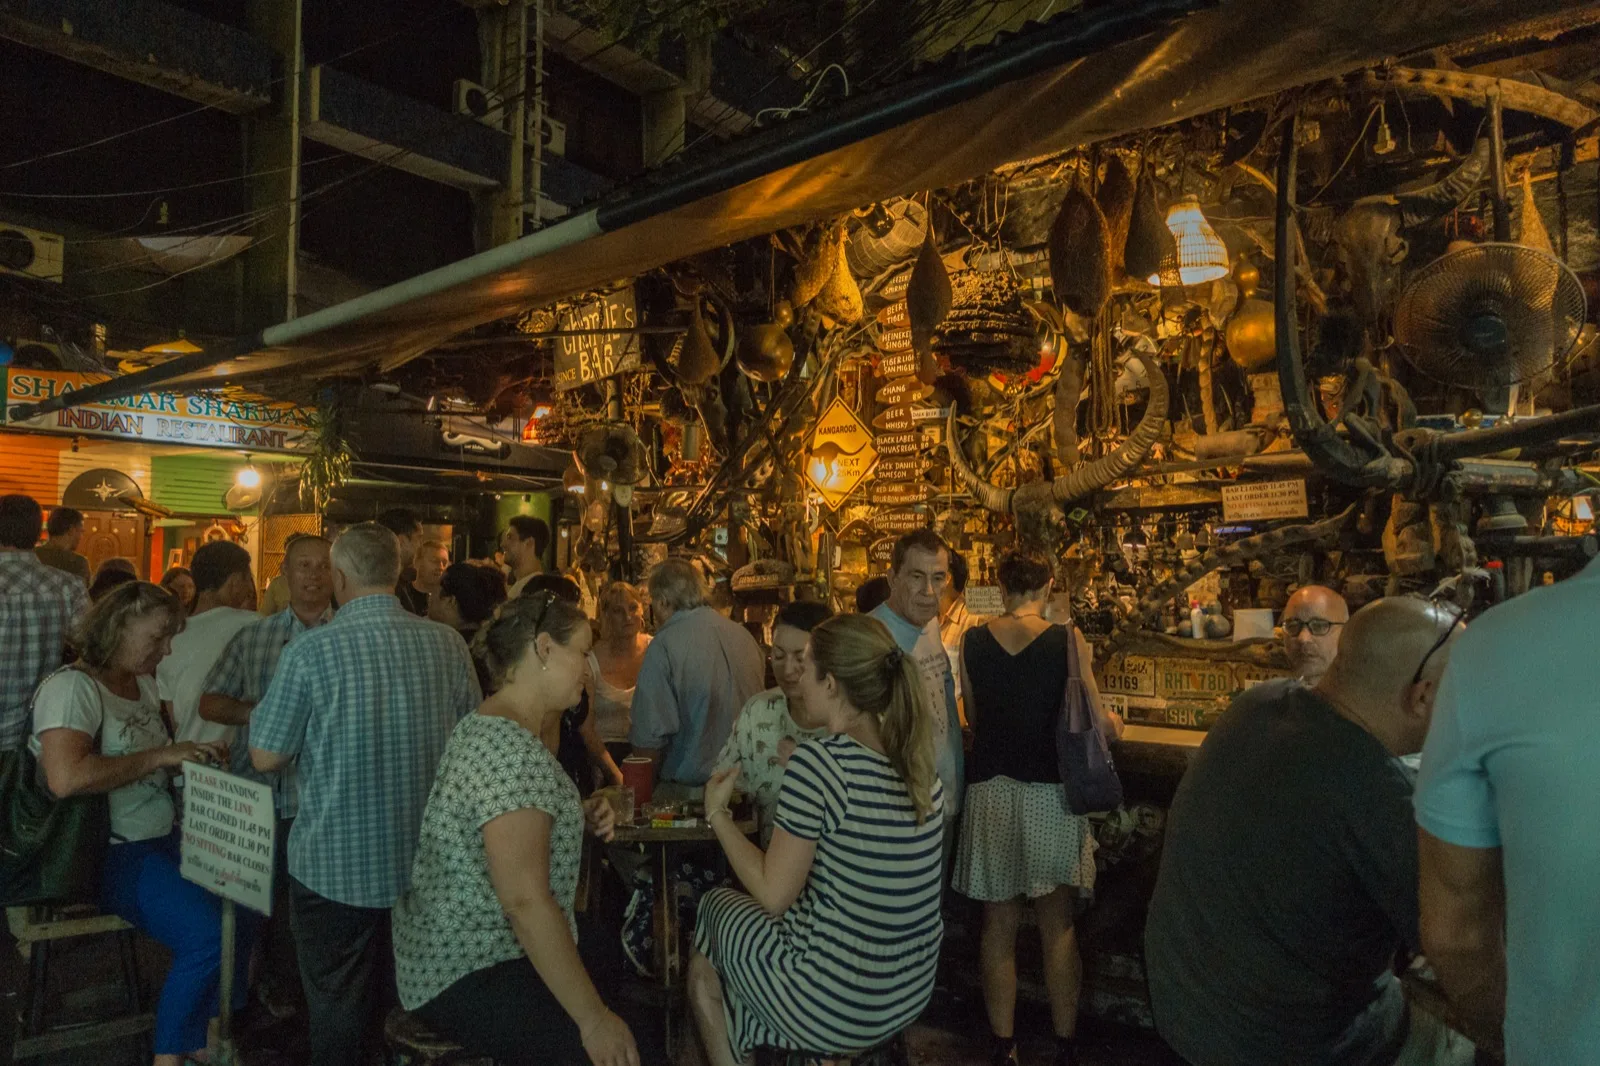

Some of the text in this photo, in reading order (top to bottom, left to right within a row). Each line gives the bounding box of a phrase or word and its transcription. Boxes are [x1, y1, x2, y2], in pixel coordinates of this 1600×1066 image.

[887, 302, 903, 316] BEER
[887, 313, 905, 324] TIGER
[579, 344, 614, 381] BAR
[883, 356, 902, 367] TIGER
[884, 365, 895, 375] SAN
[883, 385, 906, 397] CHANG
[888, 394, 901, 404] LEO
[886, 408, 905, 420] BEER
[57, 407, 288, 449] INDIAN RESTAURANT
[819, 423, 857, 436] KANGAROOS
[885, 421, 909, 430] WHISKY
[877, 436, 896, 446] BLACK
[896, 434, 914, 444] LABEL
[877, 445, 900, 455] CHIVAS
[900, 443, 918, 453] REGAL
[838, 457, 860, 467] NEXT
[878, 461, 894, 471] JACK
[895, 460, 918, 470] DANIEL
[878, 470, 907, 479] JAMESON
[876, 485, 887, 493] RED
[1225, 486, 1239, 494] BAR
[1240, 484, 1269, 493] CLOSED
[1226, 494, 1243, 502] LAST
[1244, 492, 1269, 501] ORDER
[1288, 489, 1299, 497] PM
[878, 542, 890, 551] GIN
[1103, 675, 1138, 690] 13169
[1164, 672, 1192, 690] RHT
[190, 769, 260, 803] PLEASE STANDING
[190, 786, 254, 817] INSIDE THE LINE
[190, 802, 206, 816] BAR
[206, 808, 238, 828] CLOSED
[258, 825, 271, 841] PM
[189, 817, 208, 834] LAST
[208, 824, 236, 845] ORDER
[256, 841, 270, 858] PM
[184, 831, 271, 874] NO SITTING BAR CLOSES
